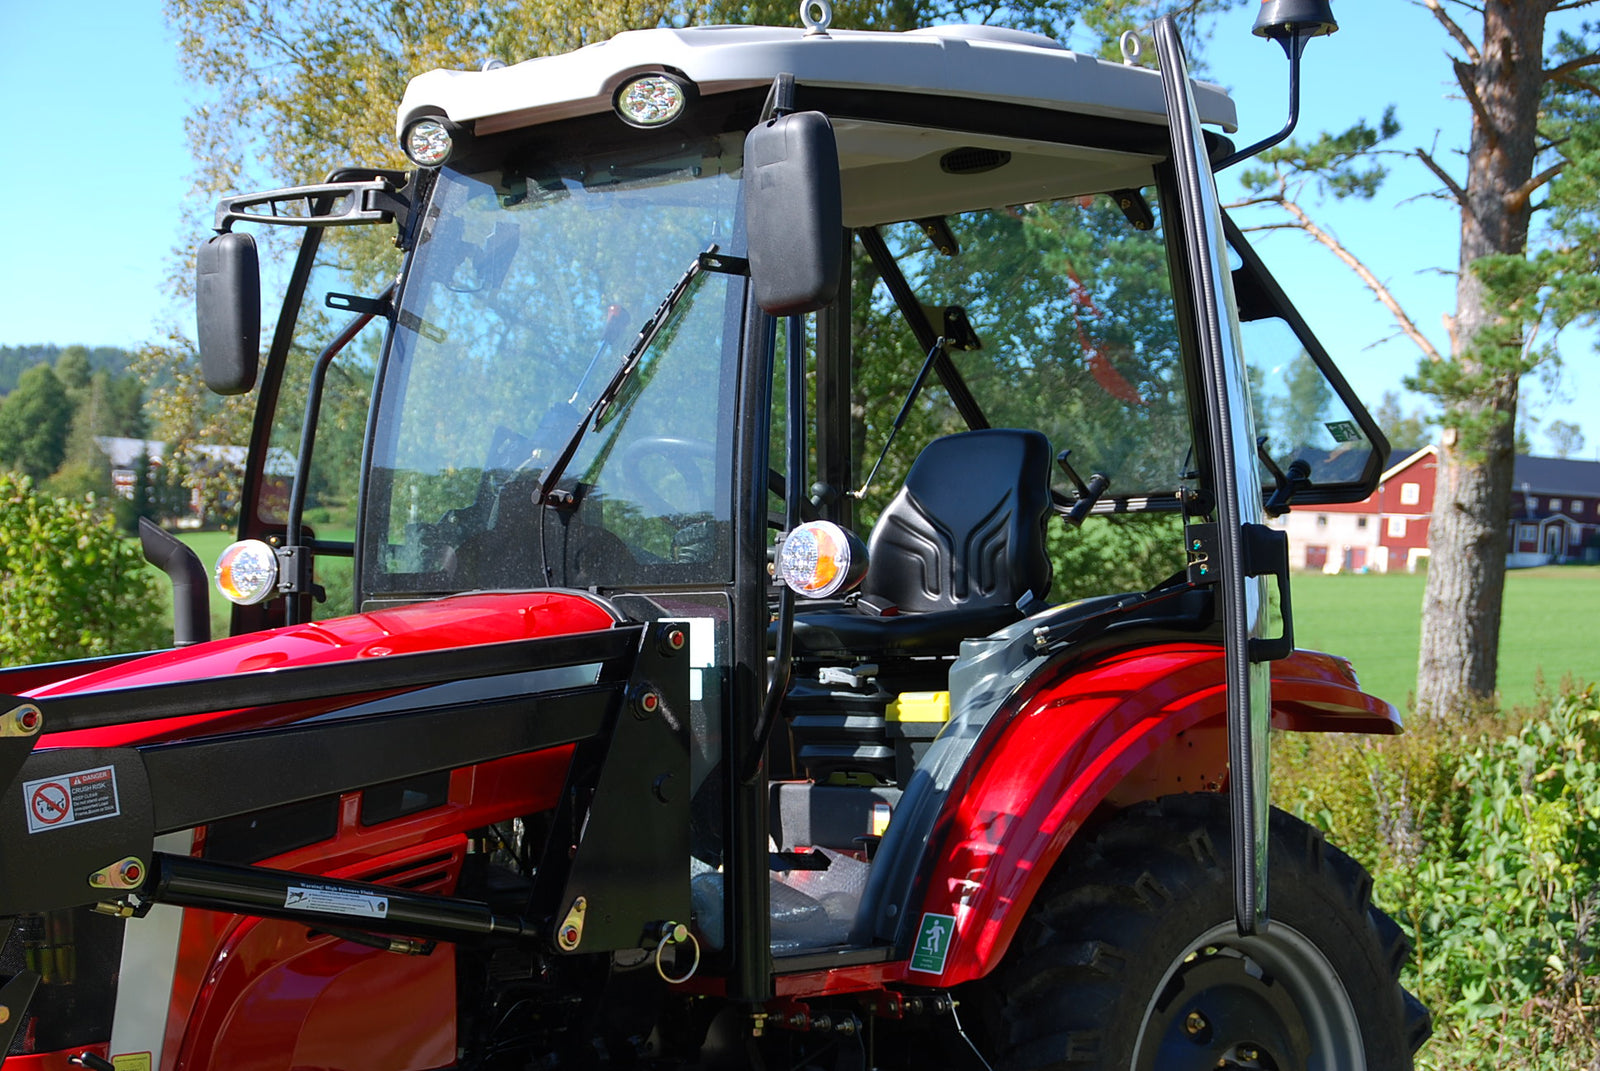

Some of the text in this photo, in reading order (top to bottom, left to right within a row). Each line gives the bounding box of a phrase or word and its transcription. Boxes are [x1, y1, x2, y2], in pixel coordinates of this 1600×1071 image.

[82, 771, 107, 781] DANGER
[72, 786, 91, 794] CRUSH
[300, 882, 324, 890] Warning!
